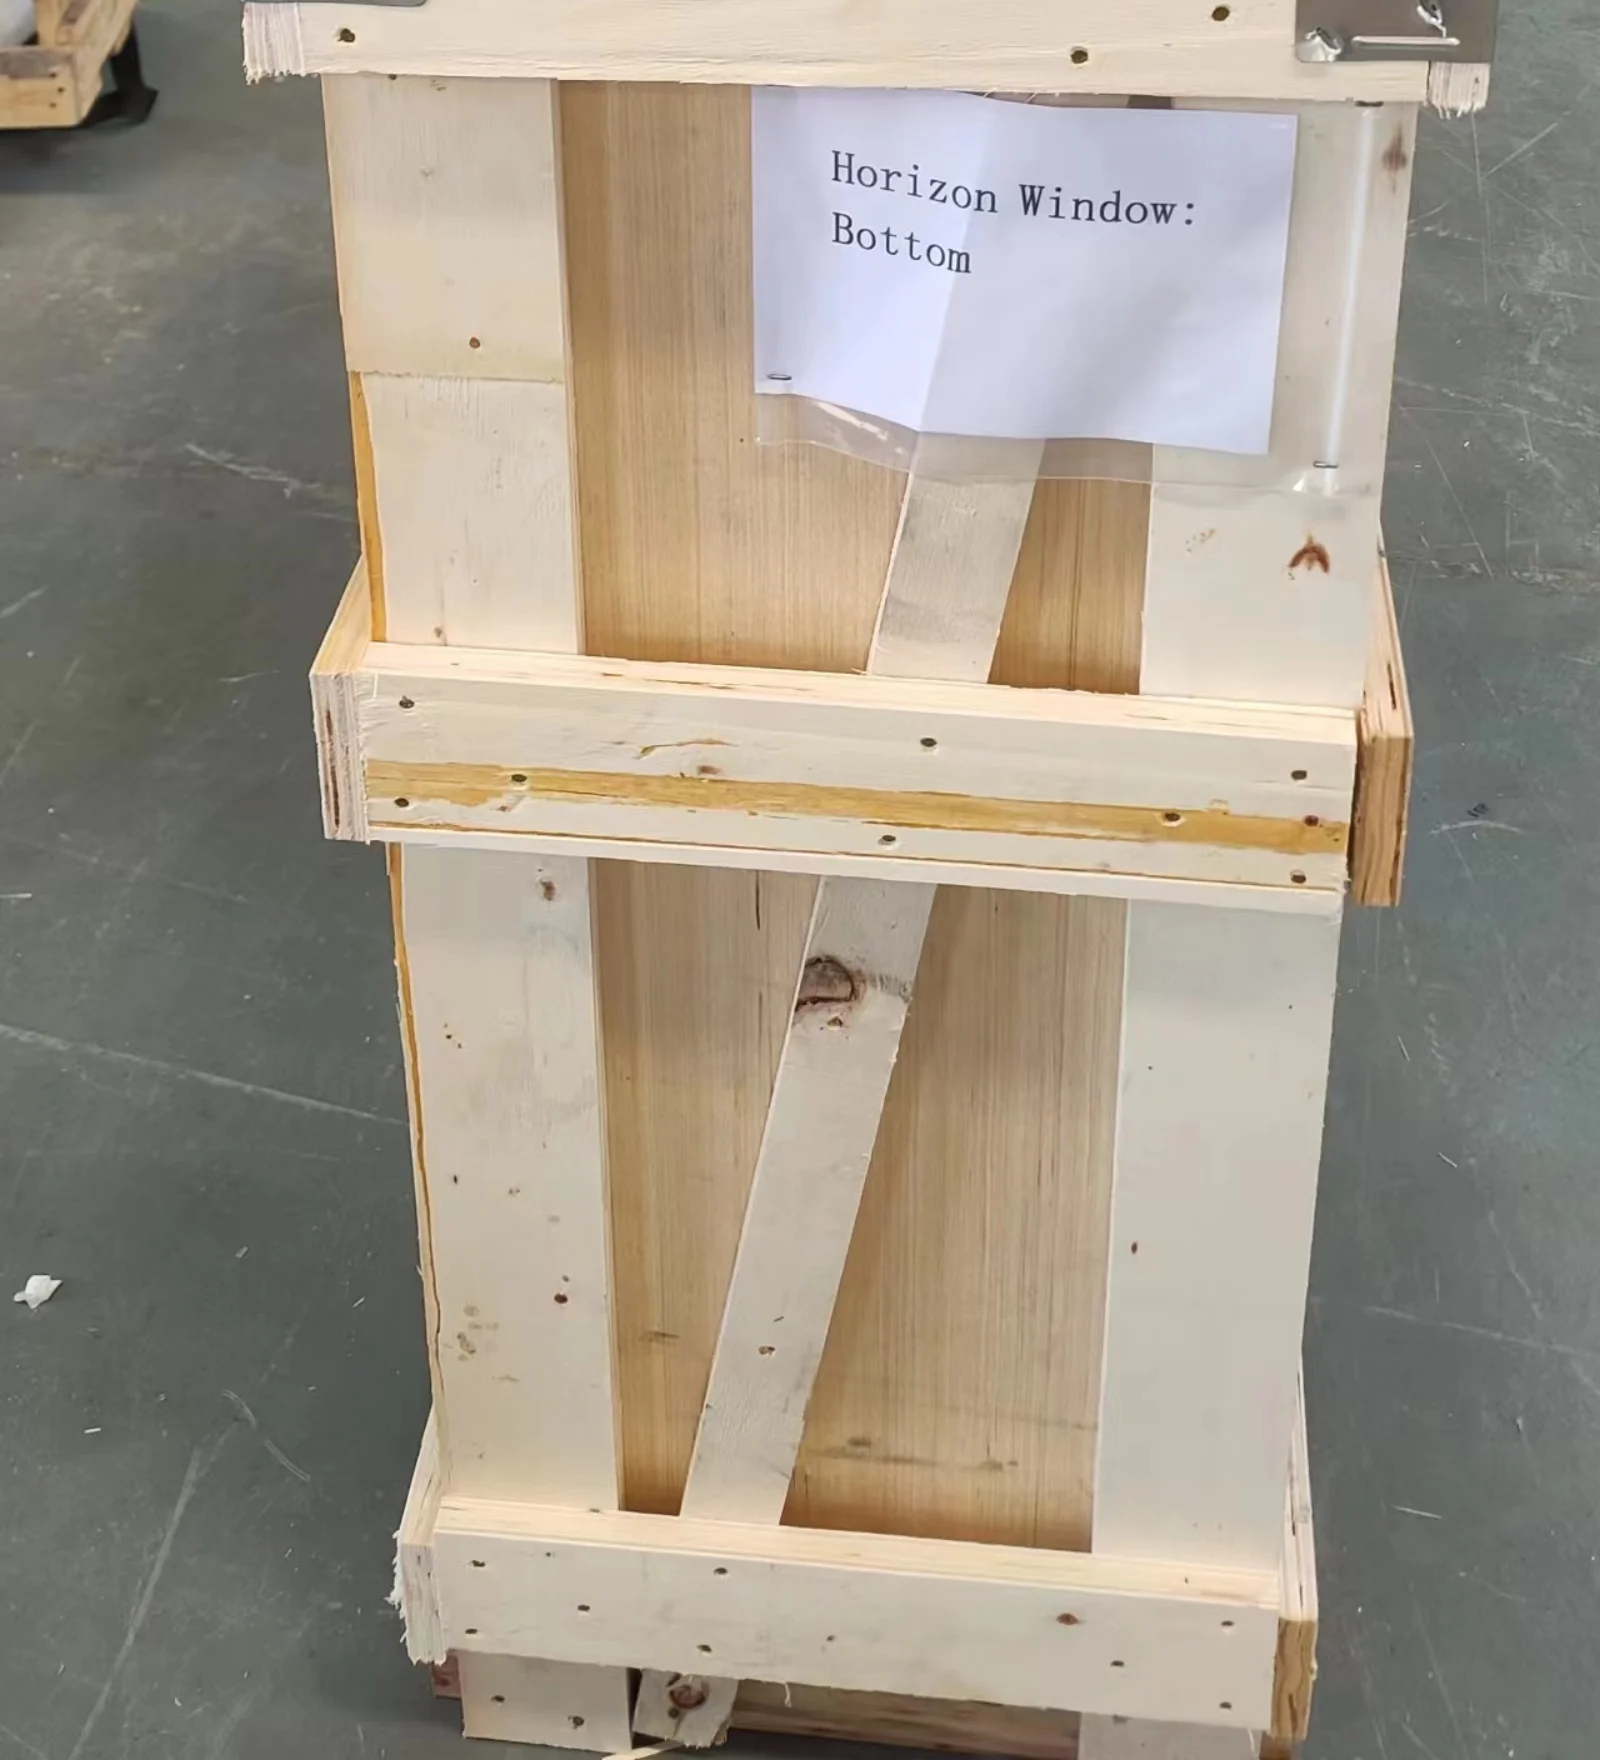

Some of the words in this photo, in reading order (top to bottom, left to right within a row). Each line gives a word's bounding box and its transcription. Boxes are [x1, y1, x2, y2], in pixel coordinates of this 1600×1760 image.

[830, 150, 998, 214] Horizon
[1018, 183, 1195, 227] Window:
[831, 211, 972, 274] Bottom
